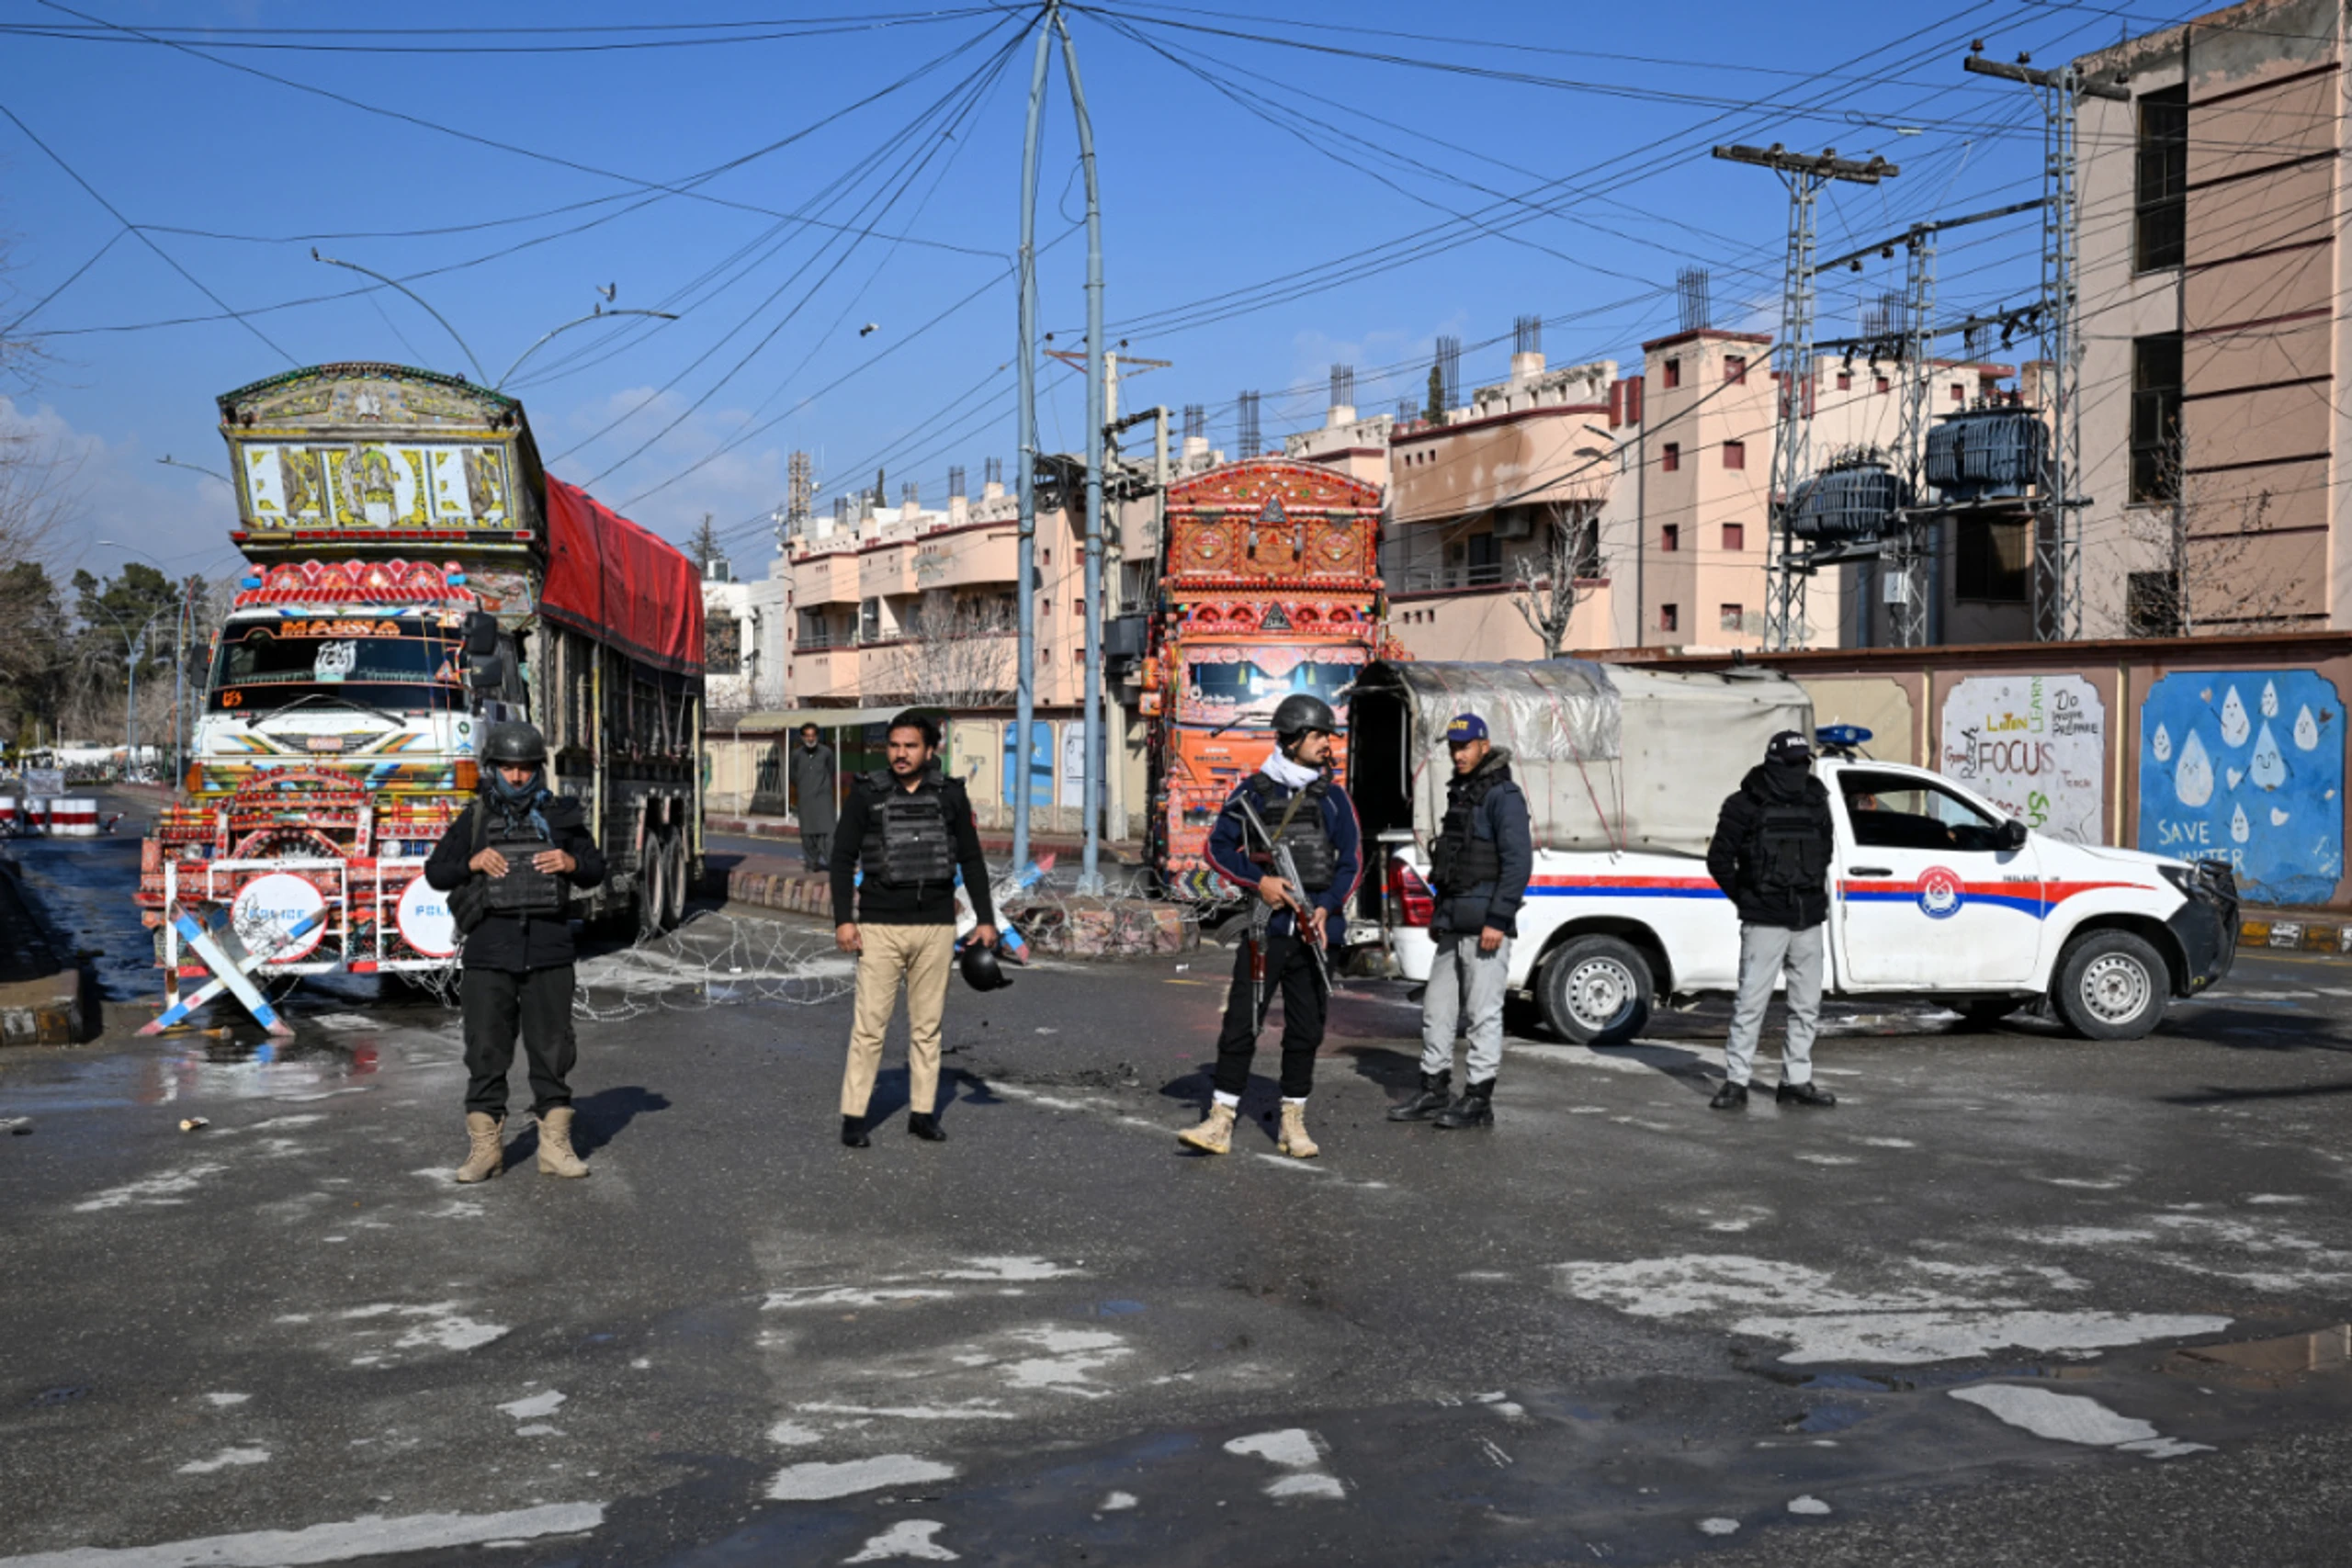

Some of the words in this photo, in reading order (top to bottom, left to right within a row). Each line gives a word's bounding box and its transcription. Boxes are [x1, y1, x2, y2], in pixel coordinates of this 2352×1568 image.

[2030, 675, 2044, 733] LEARN
[2053, 690, 2079, 711] Do
[1978, 739, 2055, 776] FOCUS
[2158, 819, 2211, 845] SAVE
